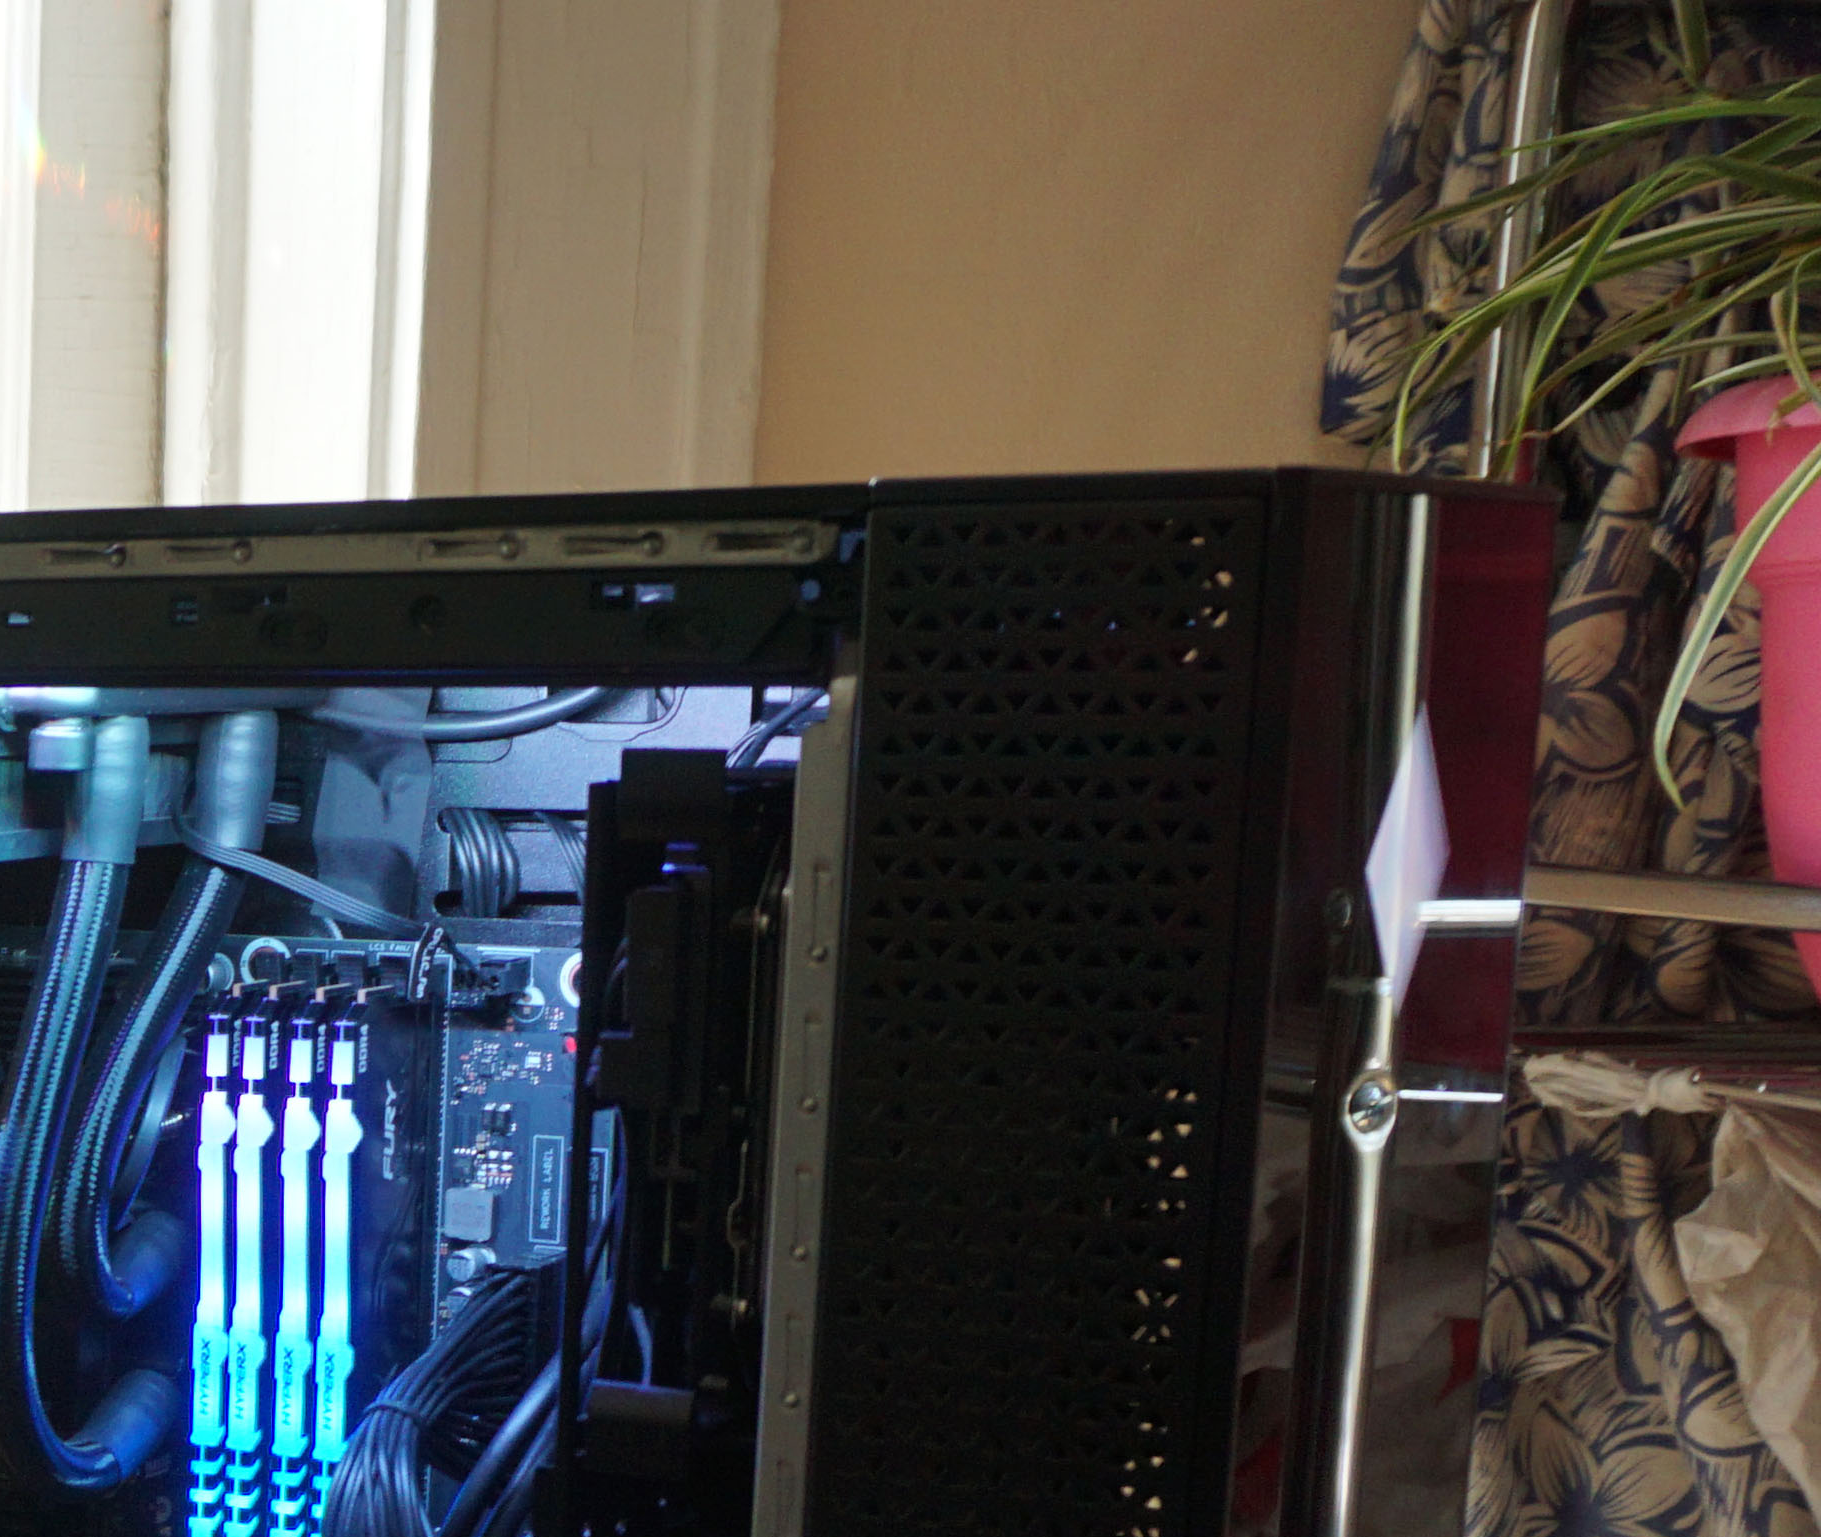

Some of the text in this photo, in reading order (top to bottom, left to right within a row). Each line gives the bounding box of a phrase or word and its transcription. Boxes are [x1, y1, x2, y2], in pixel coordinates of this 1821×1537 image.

[269, 1020, 280, 1071] DDR4
[316, 1023, 327, 1074] DDR4
[358, 1023, 369, 1074] DDR4
[382, 1079, 398, 1181] FURY
[199, 1337, 211, 1416] HYPERX
[234, 1341, 247, 1420] HYPERX
[282, 1346, 294, 1427] HYPERX
[323, 1351, 336, 1431] HYPERX
